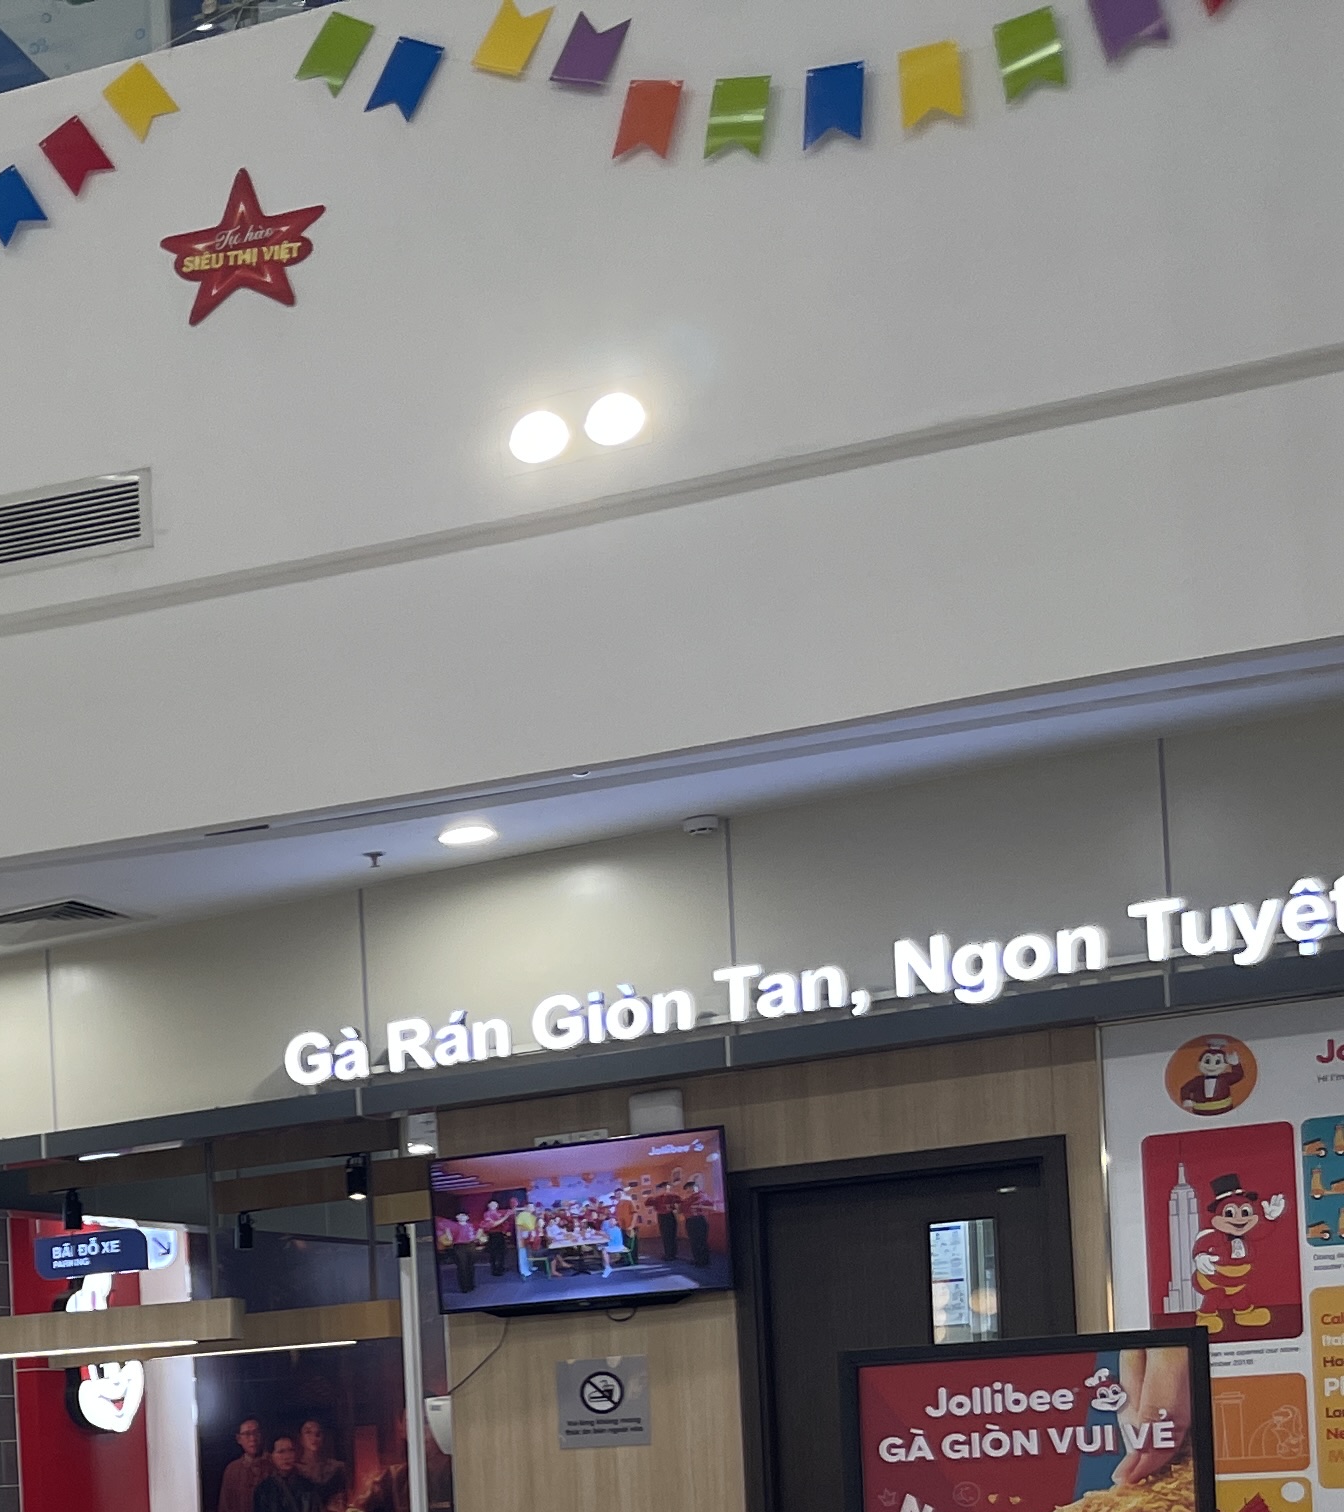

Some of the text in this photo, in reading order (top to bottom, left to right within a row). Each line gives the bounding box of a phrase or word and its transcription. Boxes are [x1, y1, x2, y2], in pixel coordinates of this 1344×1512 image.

[284, 1027, 370, 1086] Gà
[387, 1010, 512, 1074] Rán
[531, 983, 696, 1051] Giòn
[713, 964, 872, 1023] Tan,
[894, 924, 1110, 1005] Ngon
[101, 1240, 122, 1254] XE
[924, 1381, 1075, 1418] Jollibee
[878, 1408, 1176, 1463] GÀ GIÒN VUI VẺ
